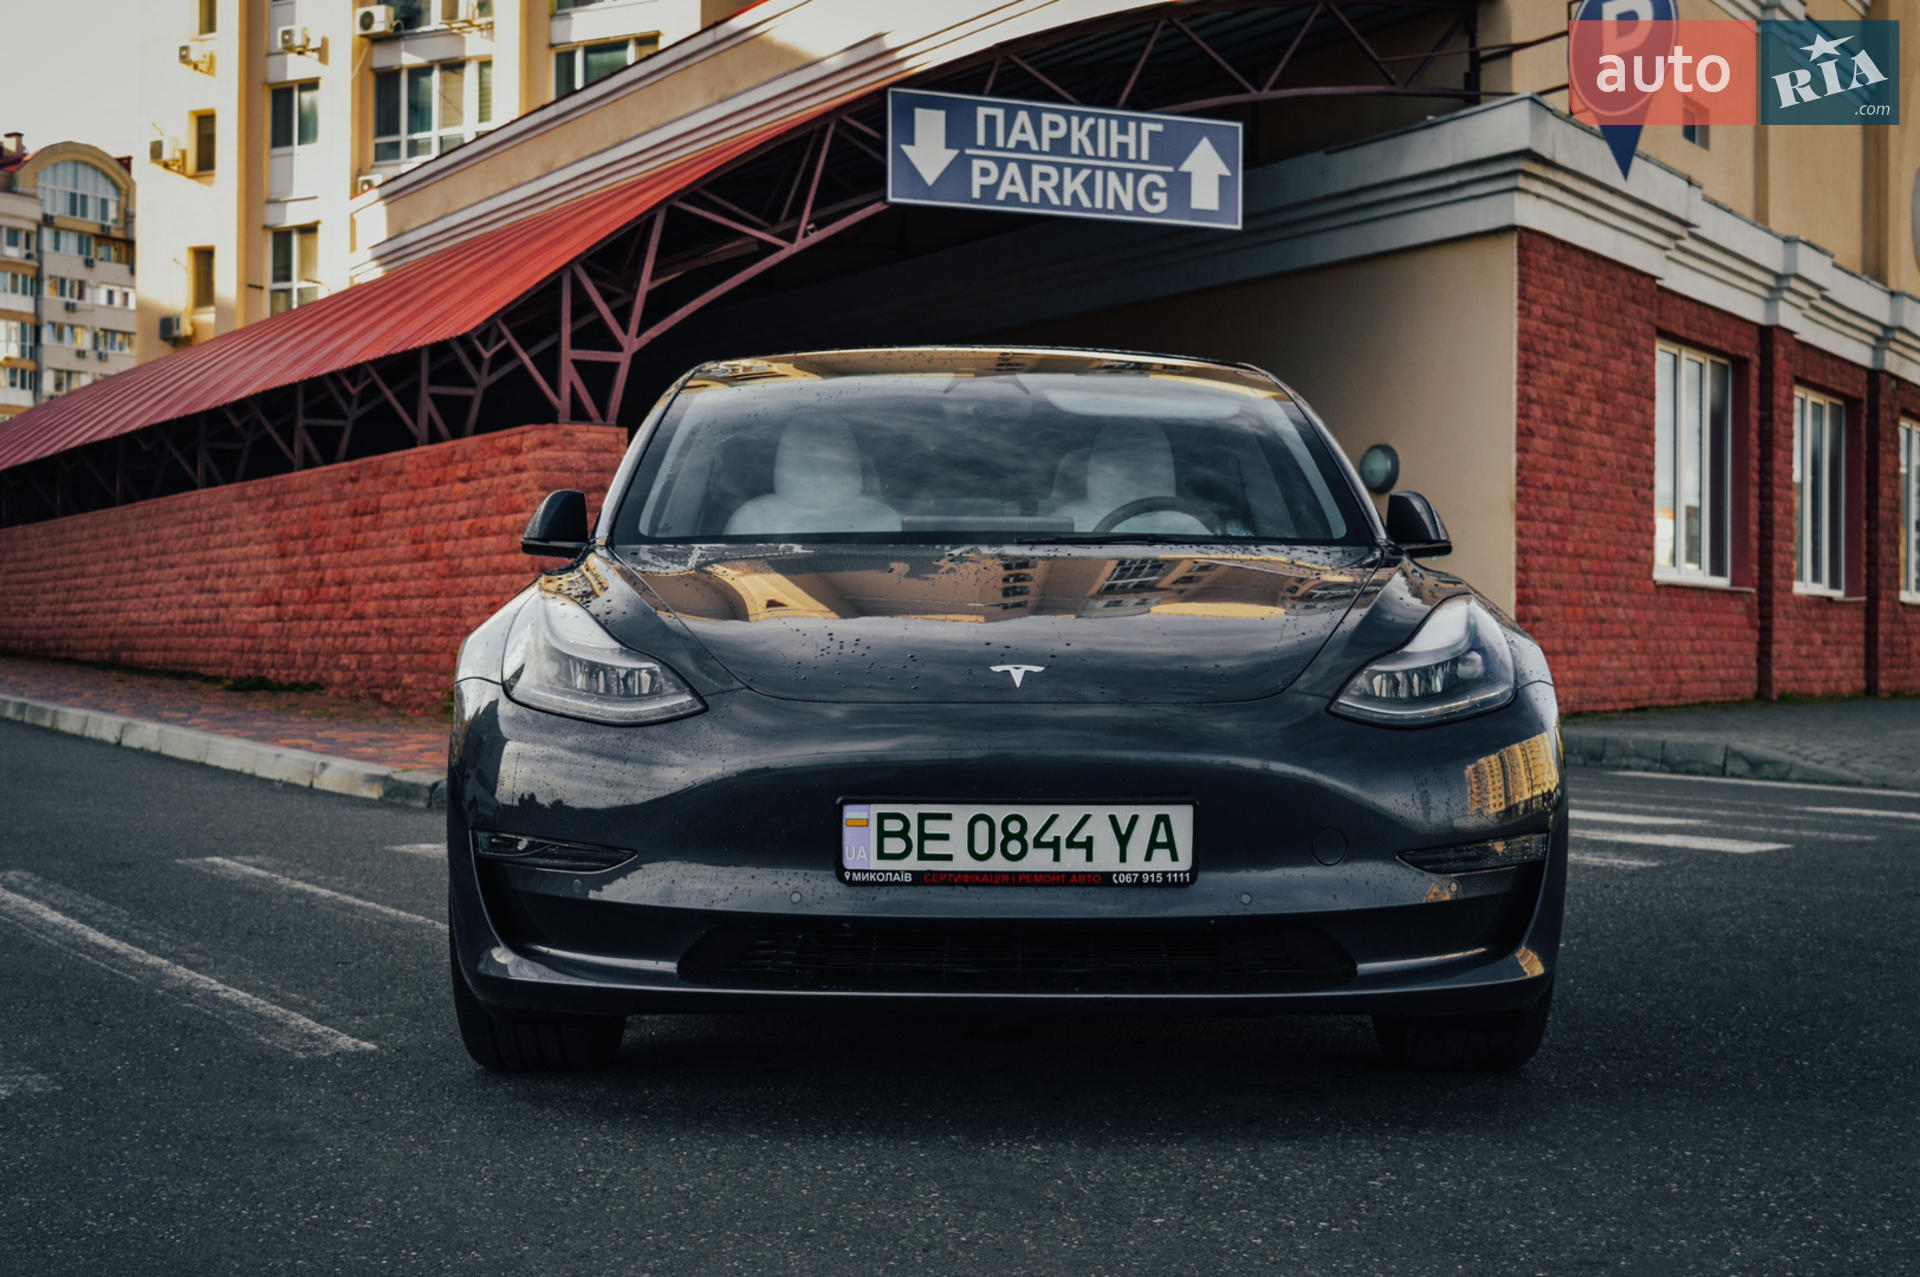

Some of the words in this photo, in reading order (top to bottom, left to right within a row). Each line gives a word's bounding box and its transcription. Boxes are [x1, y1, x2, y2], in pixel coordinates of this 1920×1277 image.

[976, 106, 1164, 161] ПАРКІНГ
[971, 159, 1168, 214] PARKING
[845, 846, 868, 861] UA
[877, 812, 953, 861] BE
[967, 813, 1095, 863] 0844
[1108, 814, 1179, 863] YA
[851, 871, 913, 882] МИКОЛАЇВ
[924, 872, 1009, 885] СЕРТИФІКАЦІЯ
[1019, 874, 1066, 883] РЕМОНТ
[1070, 874, 1102, 883] АВТО
[1118, 872, 1139, 883] 067
[1142, 872, 1163, 883] 915
[1166, 872, 1191, 883] 1111
